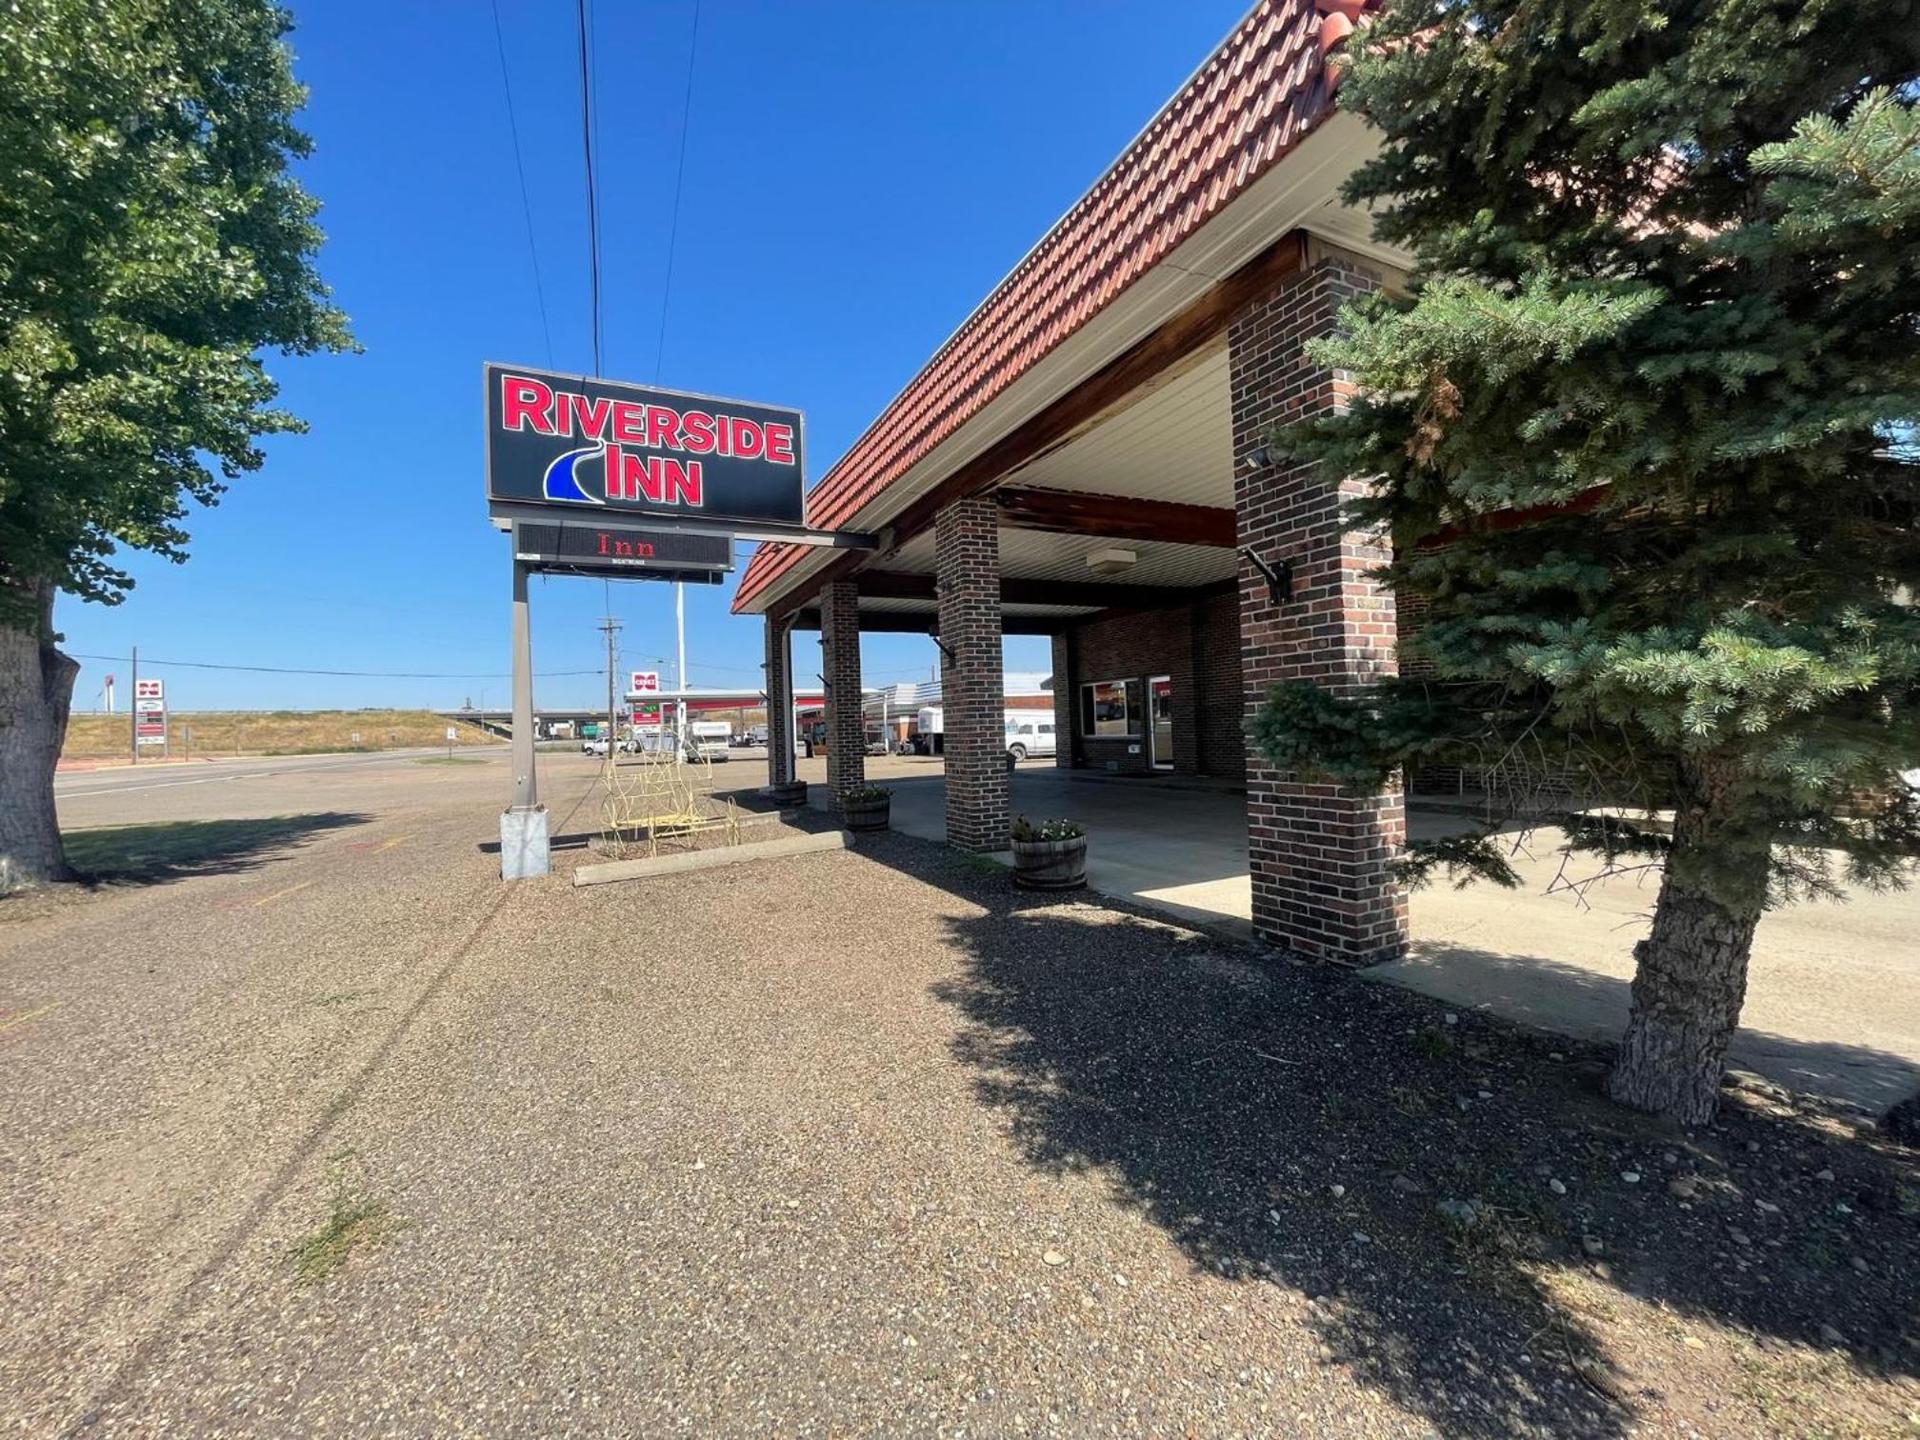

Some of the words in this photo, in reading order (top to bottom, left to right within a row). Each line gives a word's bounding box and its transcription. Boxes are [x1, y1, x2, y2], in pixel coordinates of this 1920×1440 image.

[502, 374, 795, 465] RIVERSIDE
[604, 443, 703, 507] INN
[597, 532, 656, 557] Inn
